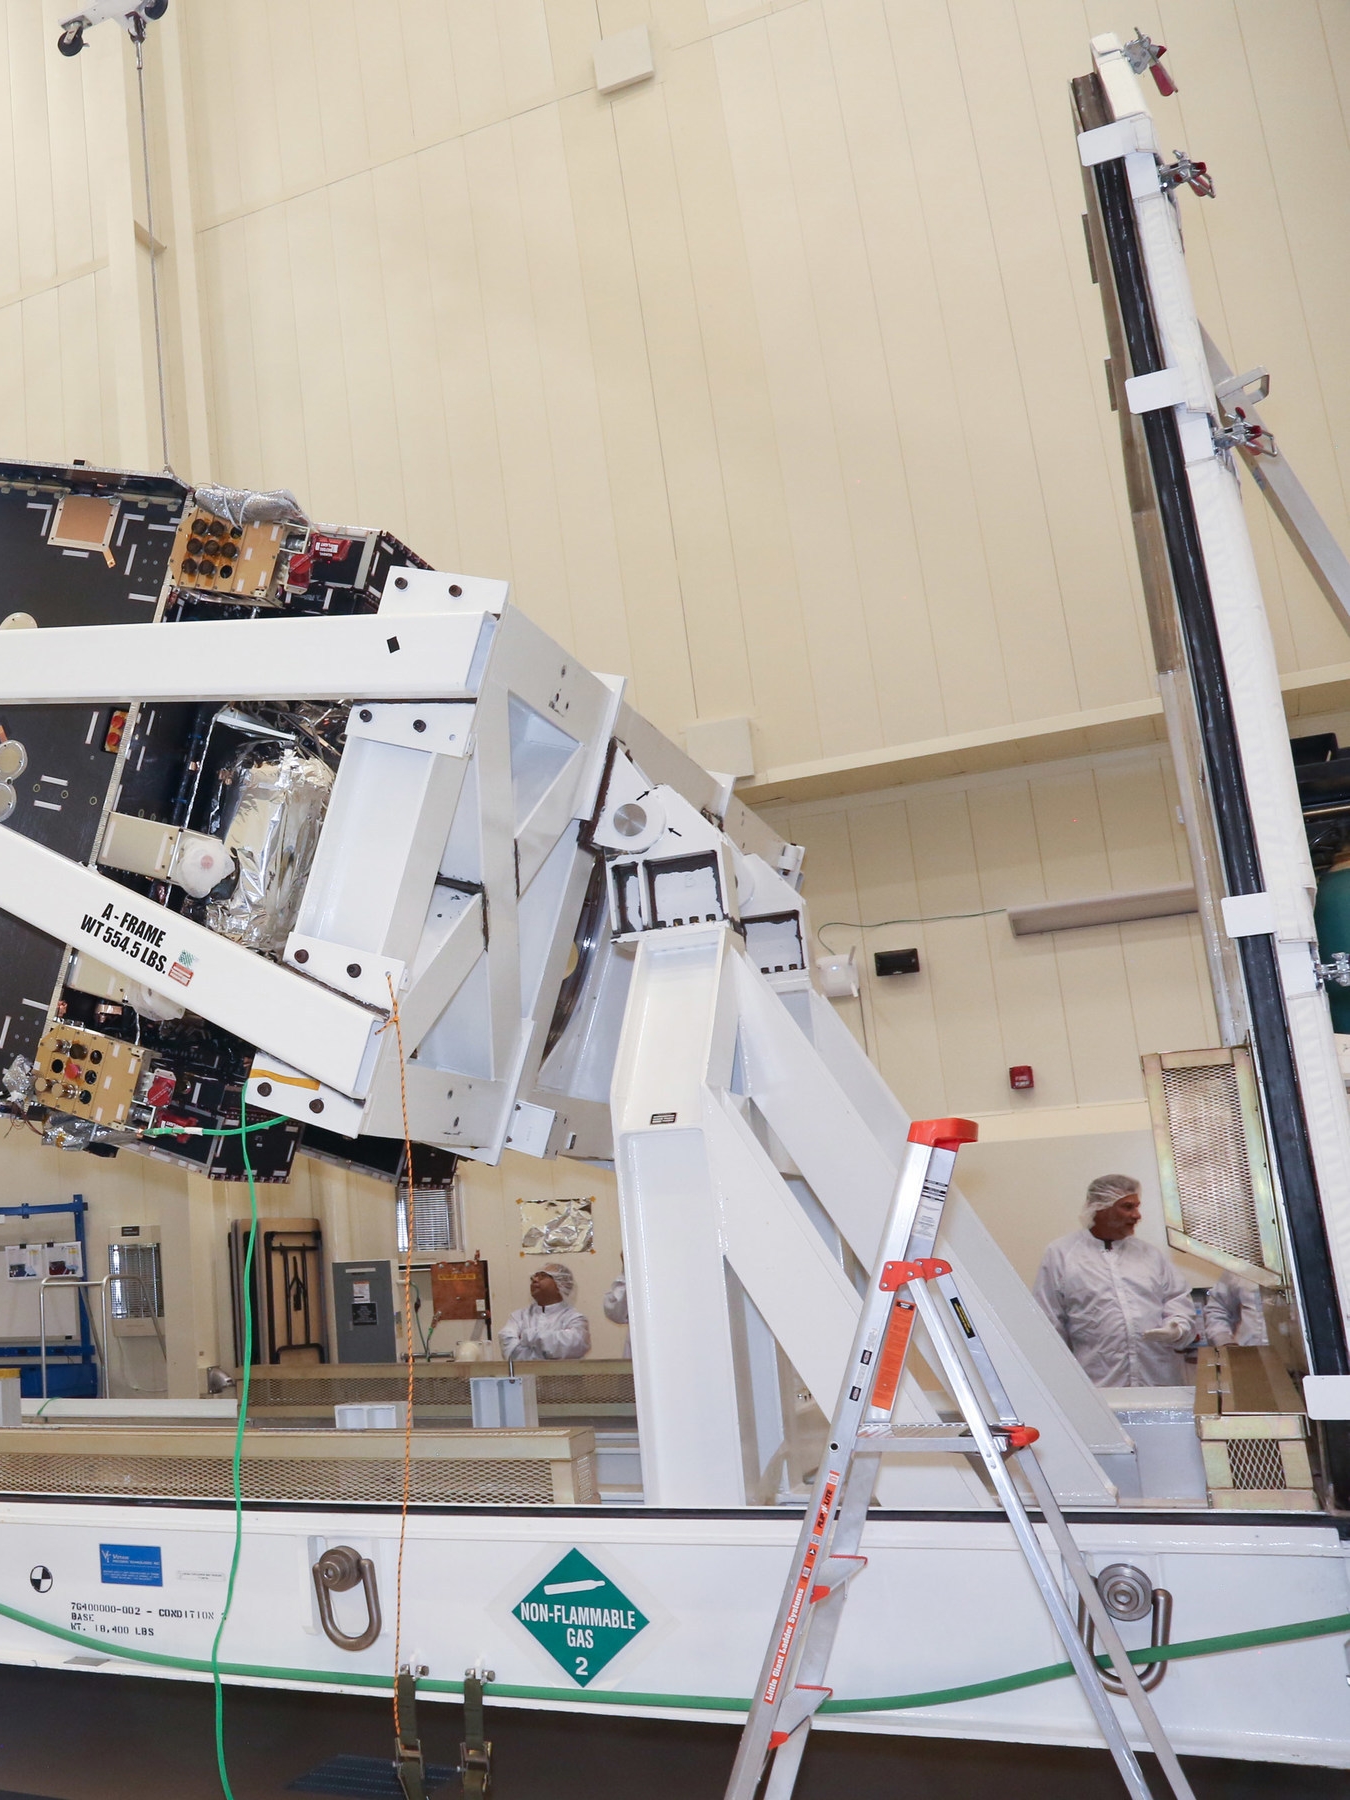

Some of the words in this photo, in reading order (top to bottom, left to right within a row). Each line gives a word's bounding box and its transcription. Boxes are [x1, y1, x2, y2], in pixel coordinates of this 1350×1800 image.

[100, 903, 114, 921] A
[119, 911, 167, 948] FRAME
[80, 914, 105, 938] WT
[102, 926, 142, 959] 554.5
[139, 947, 168, 975] LBS.
[71, 1612, 95, 1622] BASE
[158, 1608, 215, 1620] CONDITION
[520, 1602, 637, 1630] NON-FLAMMABLE
[787, 1588, 805, 1624] Systems
[70, 1622, 86, 1631] WT.
[95, 1624, 129, 1634] 18,400
[135, 1626, 155, 1637] LBS
[566, 1627, 594, 1649] GAS
[778, 1624, 794, 1655] Ladder
[575, 1656, 589, 1676] 2
[772, 1655, 785, 1678] Giant
[765, 1678, 778, 1702] Little
